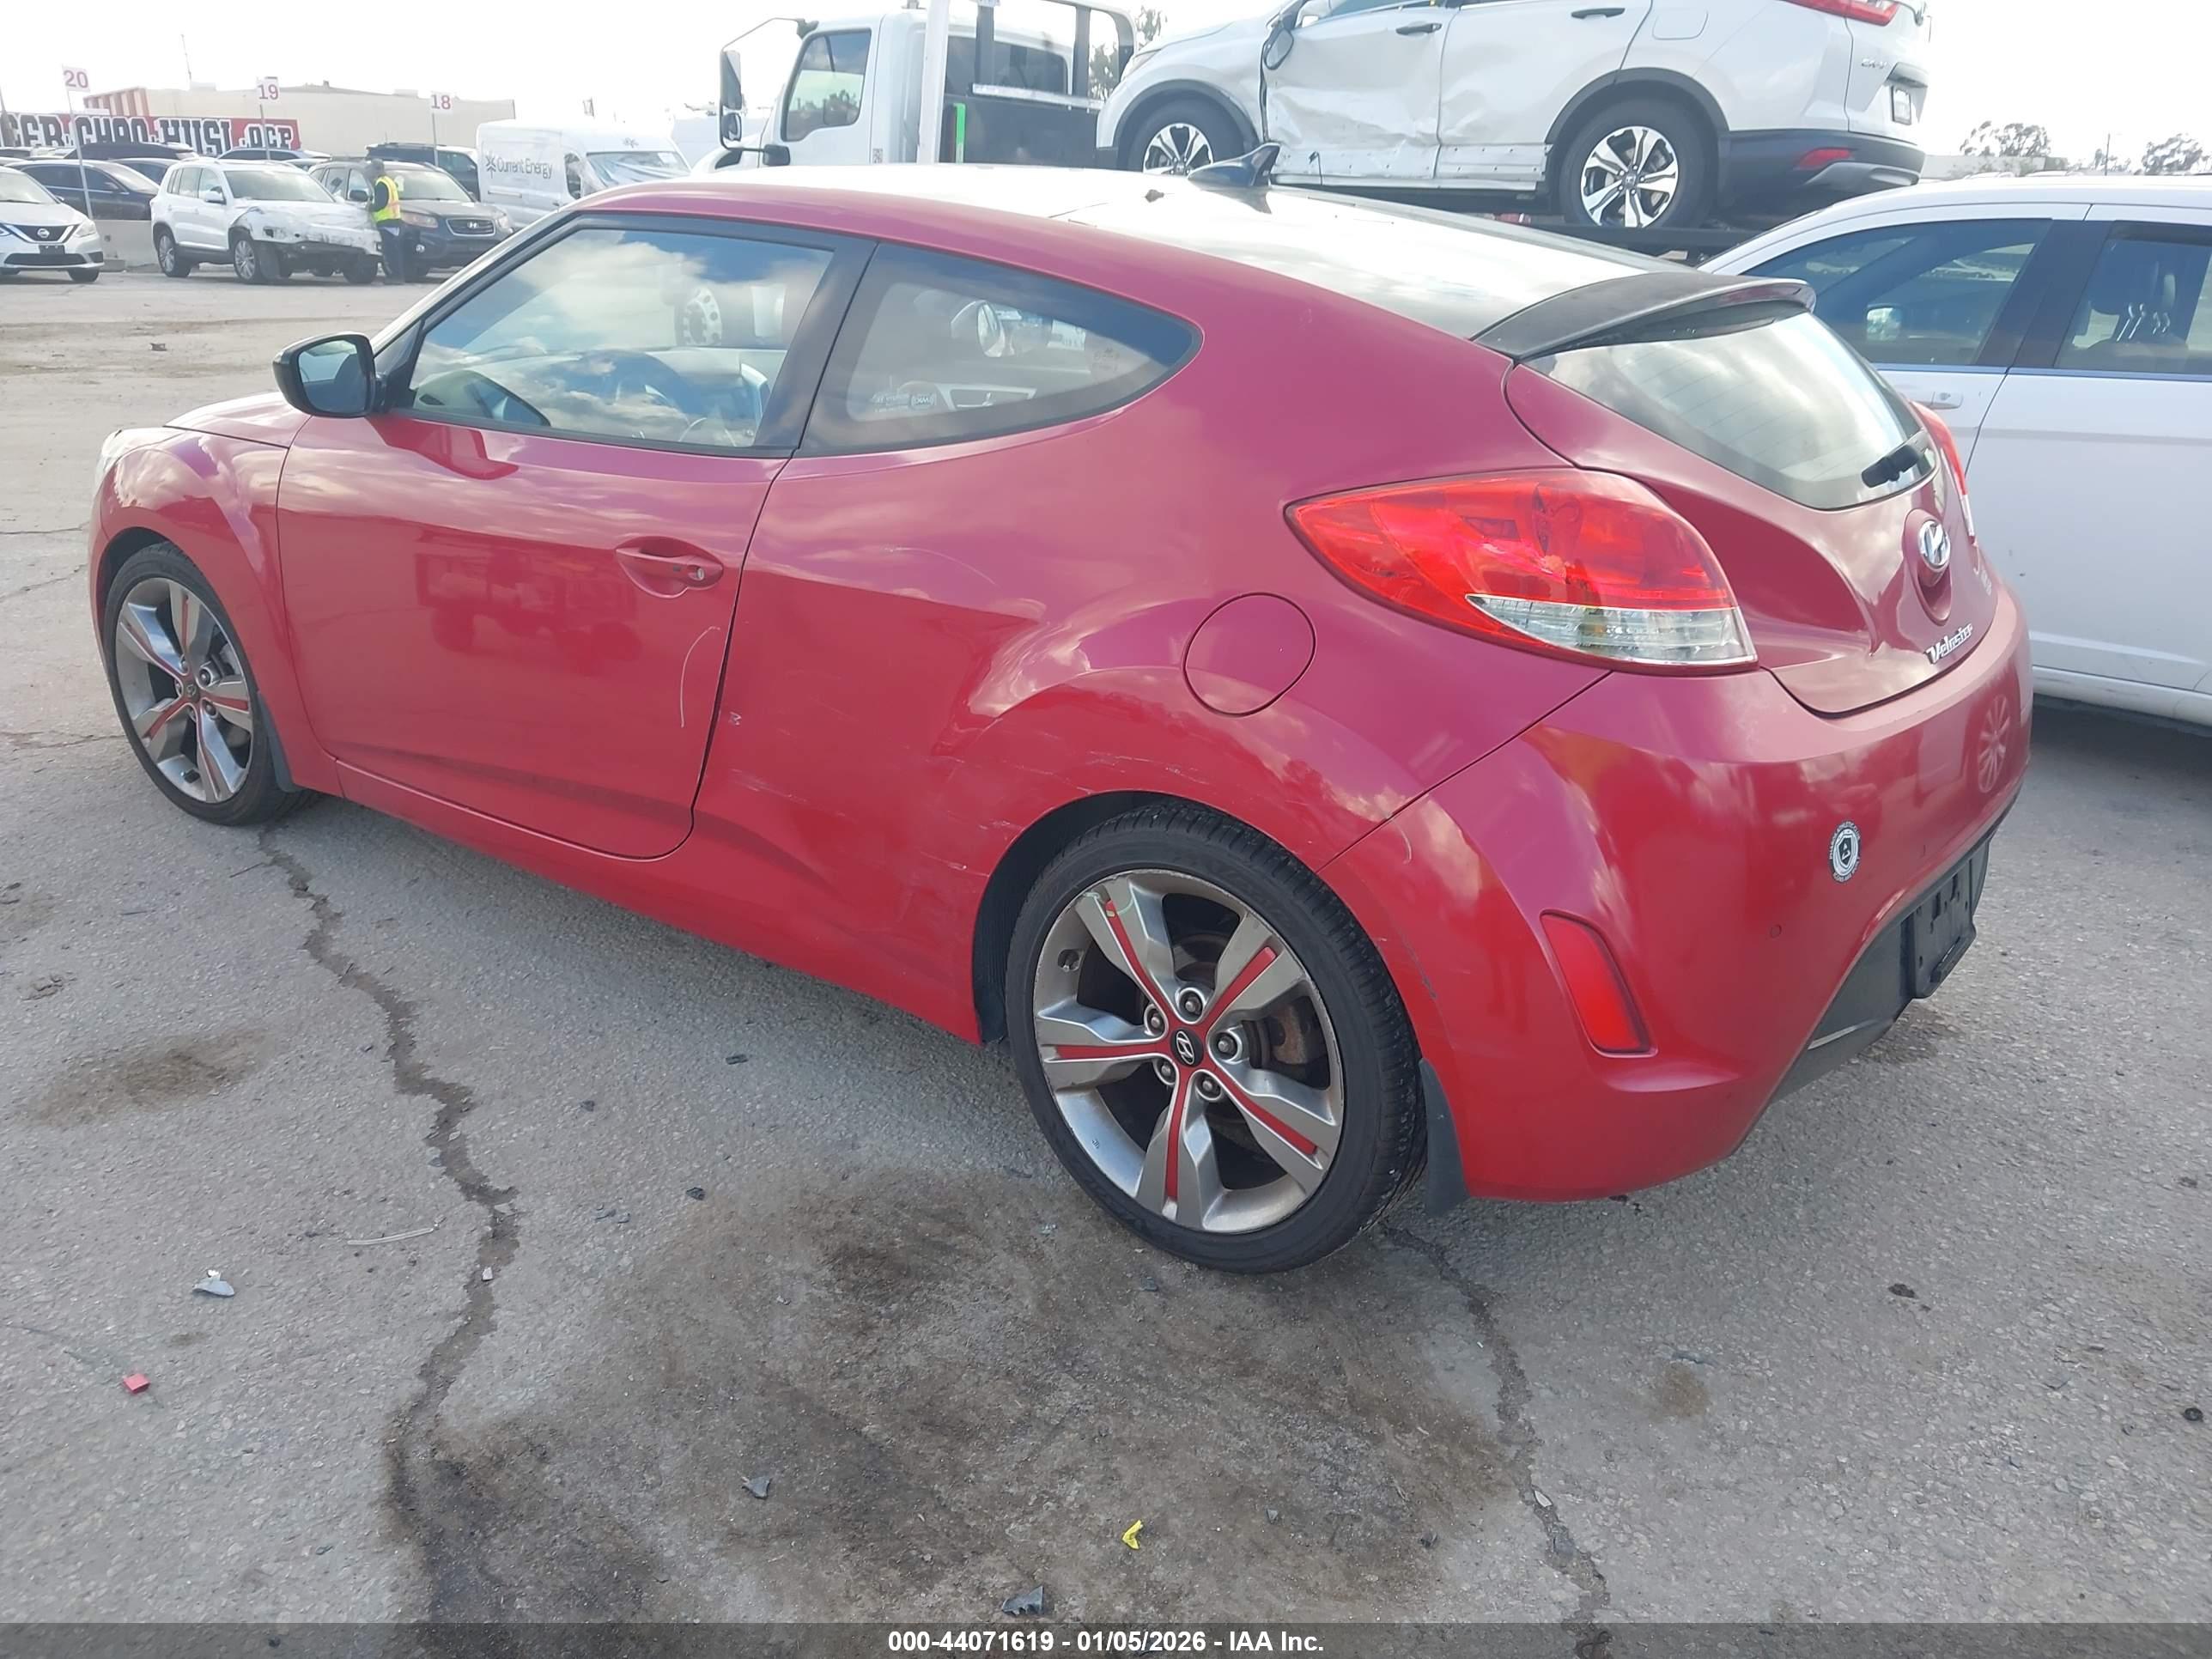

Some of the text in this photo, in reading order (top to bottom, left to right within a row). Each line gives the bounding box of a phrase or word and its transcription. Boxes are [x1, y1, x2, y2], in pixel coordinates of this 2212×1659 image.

[64, 70, 88, 88] 20
[257, 84, 278, 100] 19
[430, 94, 451, 110] 18
[526, 158, 552, 179] Energy
[1925, 623, 1973, 665] Veloster
